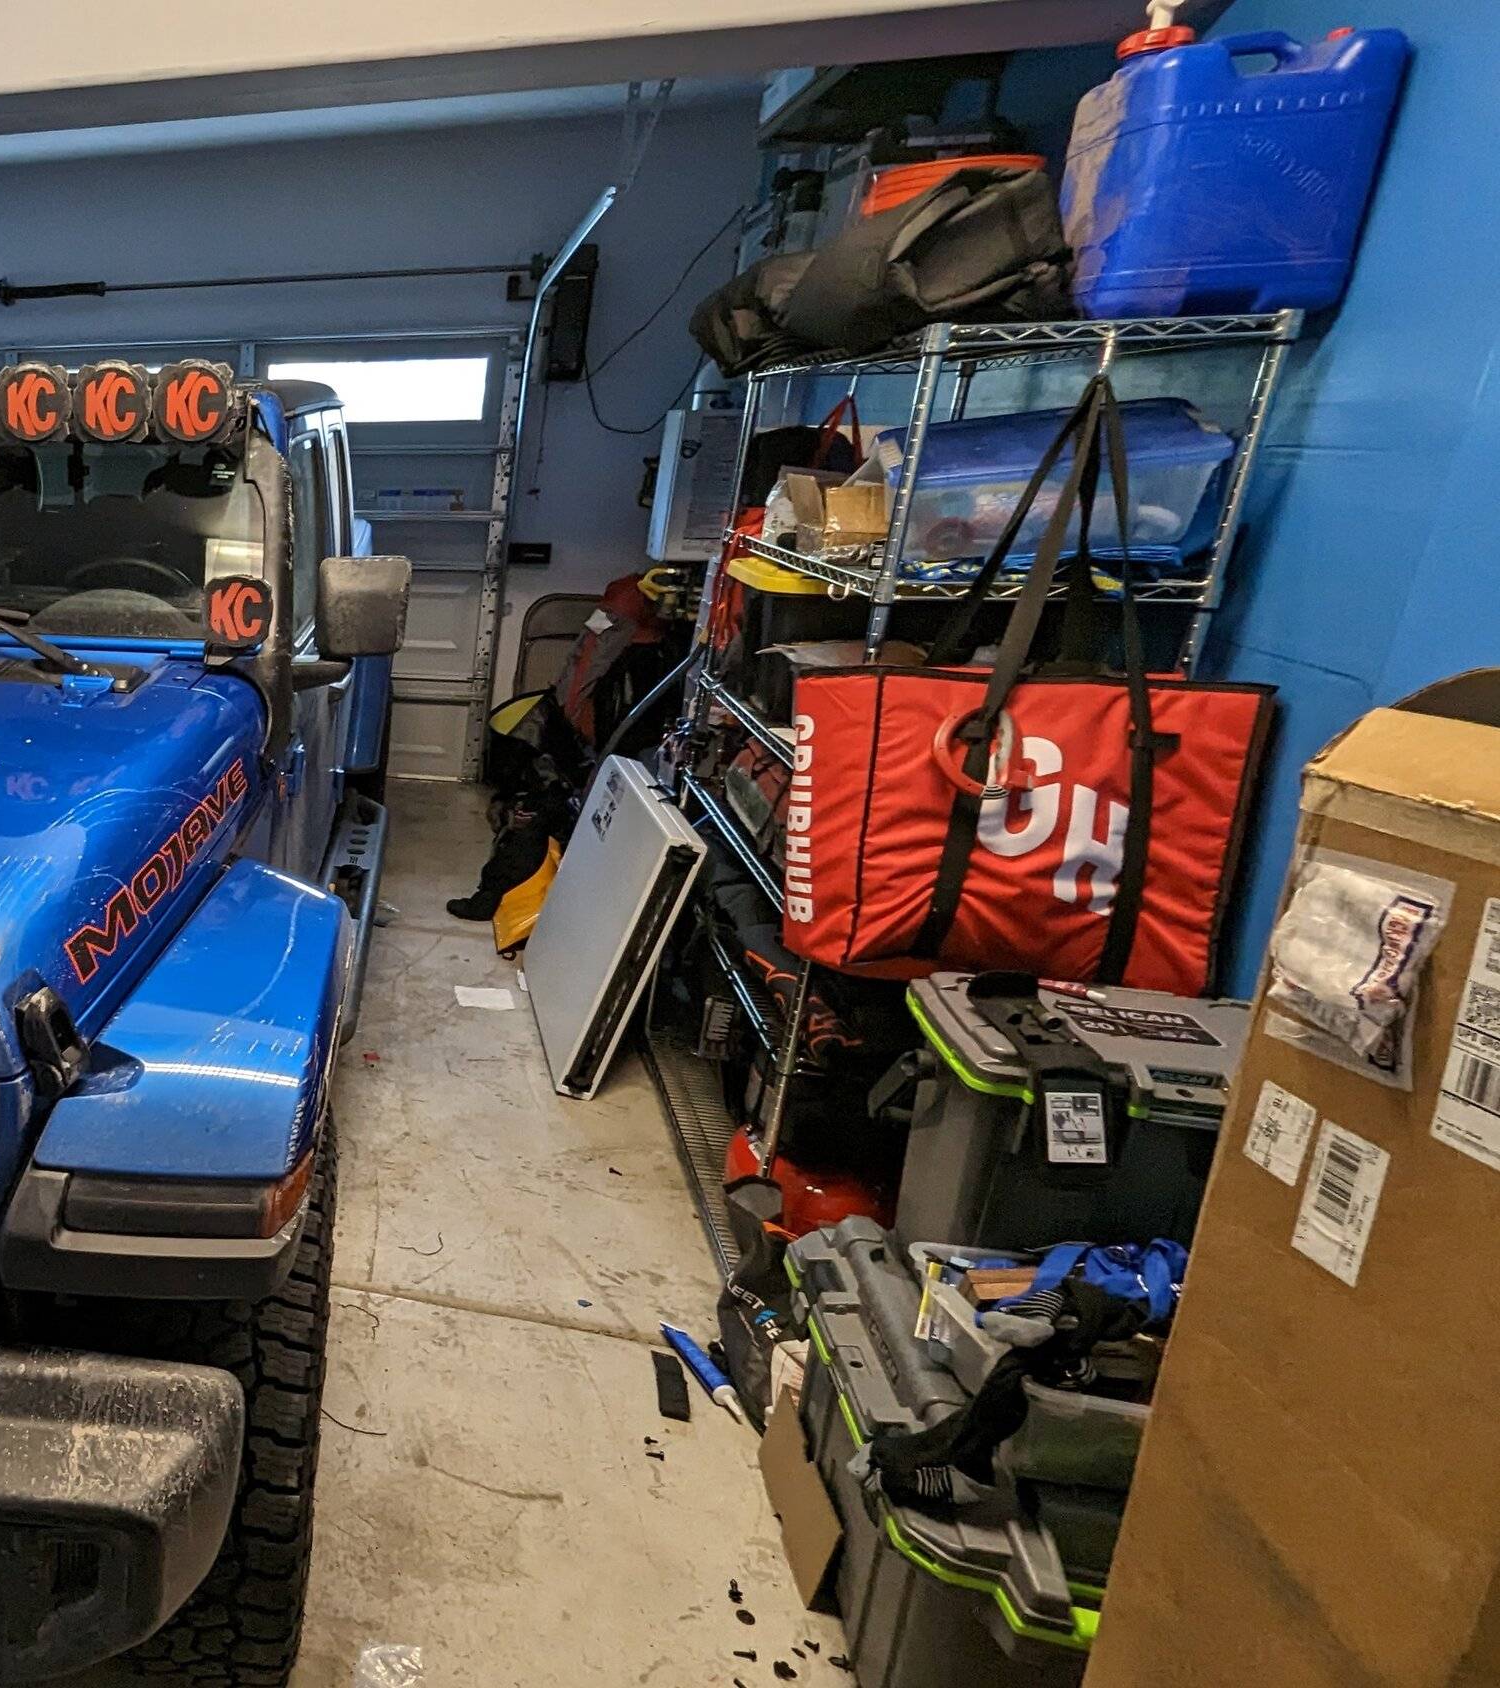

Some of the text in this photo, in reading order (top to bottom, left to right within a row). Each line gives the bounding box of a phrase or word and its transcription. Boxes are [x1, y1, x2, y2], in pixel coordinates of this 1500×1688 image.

[7, 373, 57, 436] KC
[84, 371, 136, 437] KC
[166, 371, 220, 437] KC
[210, 582, 262, 641] KC
[64, 757, 248, 985] MOJAVE
[1069, 1004, 1185, 1025] PELICAN
